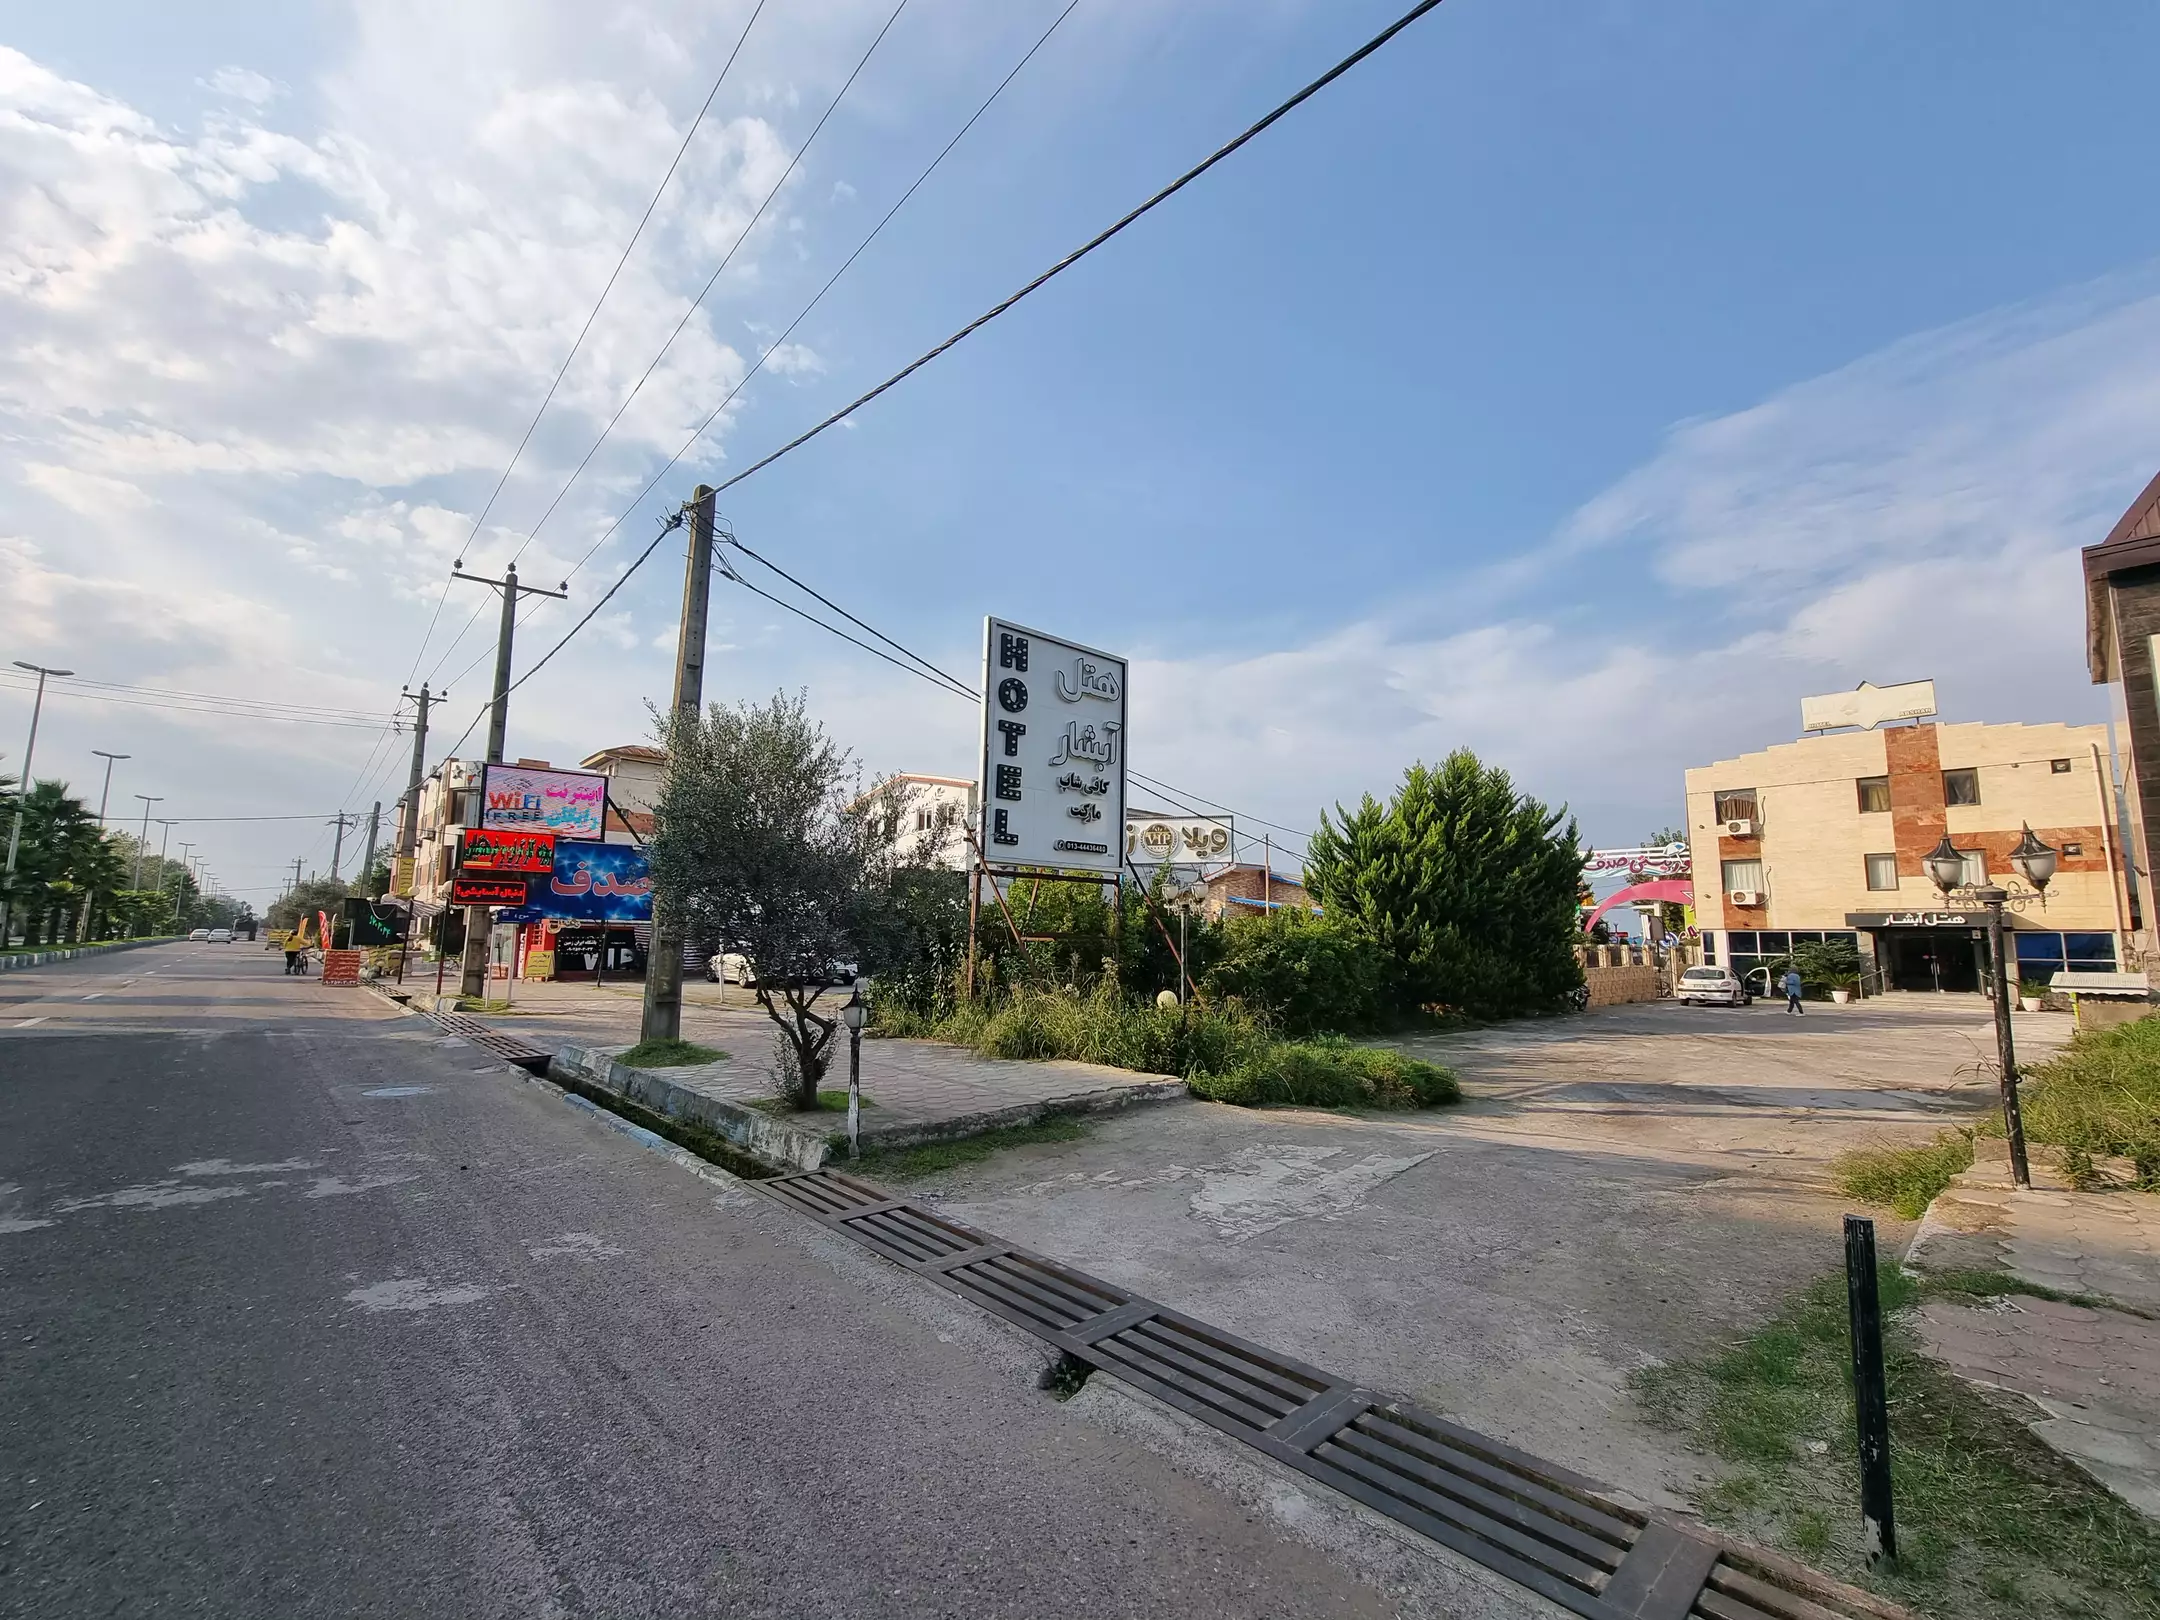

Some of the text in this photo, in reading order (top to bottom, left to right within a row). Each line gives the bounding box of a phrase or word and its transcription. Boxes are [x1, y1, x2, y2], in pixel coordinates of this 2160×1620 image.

[1056, 657, 1121, 703] هتل
[994, 632, 1029, 846] HOTEL
[1050, 720, 1122, 772] آبشار
[1058, 772, 1110, 797] کافی شاپ
[494, 811, 541, 820] FREE
[1069, 802, 1102, 823] مارکت
[1147, 833, 1171, 845] VIP
[1182, 826, 1228, 857] ویلا
[551, 861, 652, 896] صدف
[1882, 912, 1966, 926] هتل آبشار
